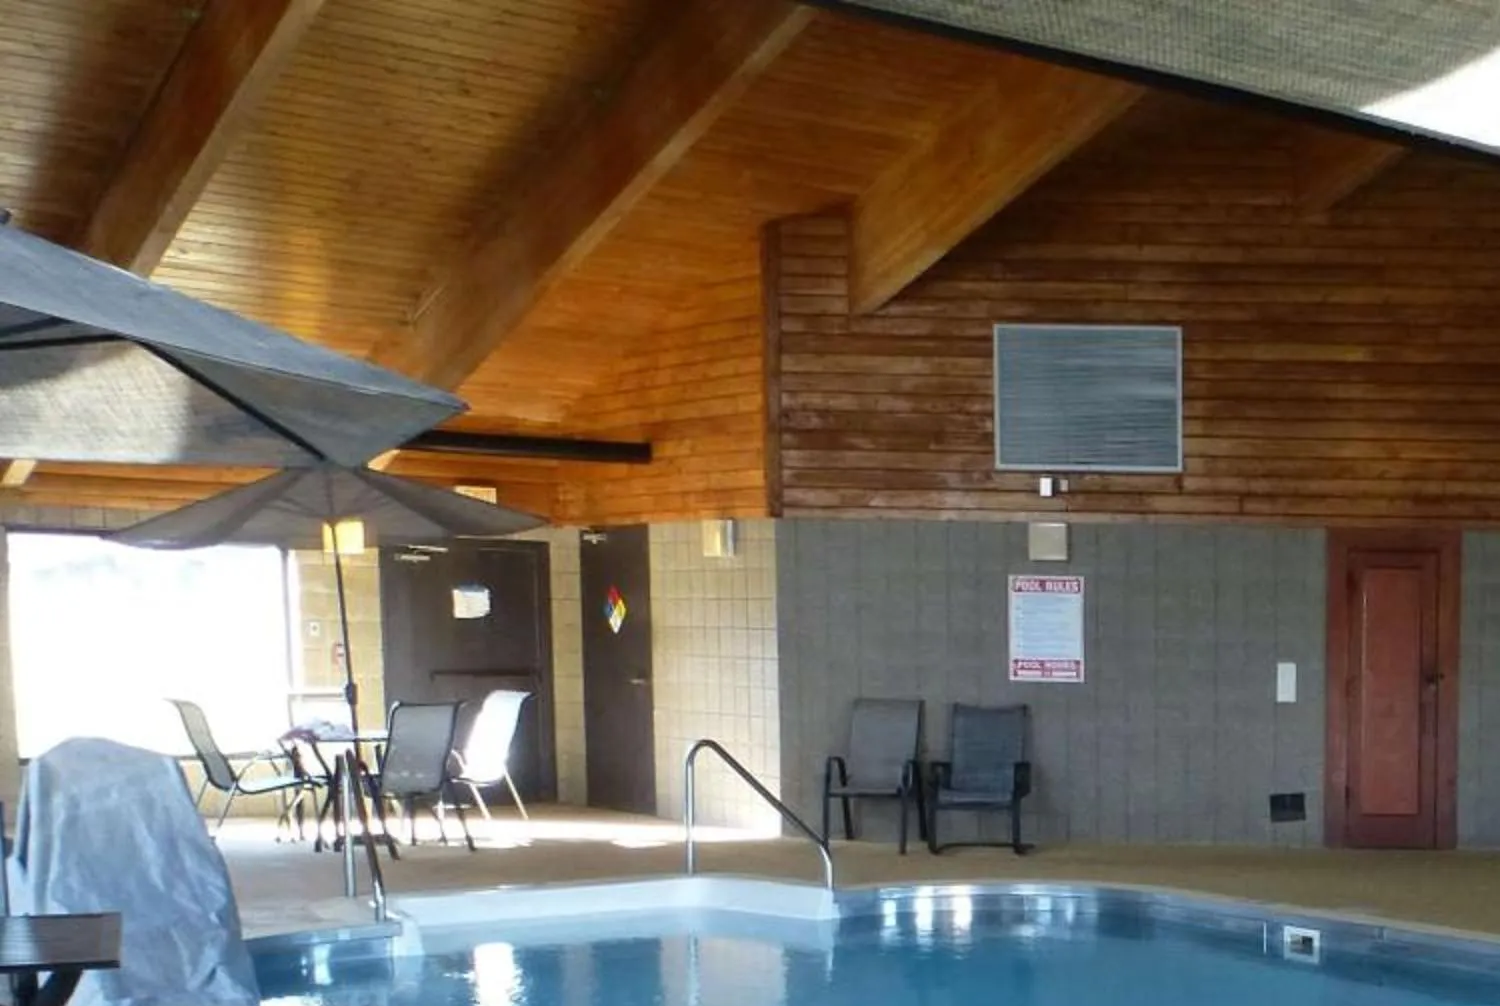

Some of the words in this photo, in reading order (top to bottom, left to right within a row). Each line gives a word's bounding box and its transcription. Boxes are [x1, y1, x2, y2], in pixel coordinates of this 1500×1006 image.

[1015, 580, 1042, 591] POOL
[1045, 580, 1079, 592] RULES
[1017, 661, 1041, 669] POOL
